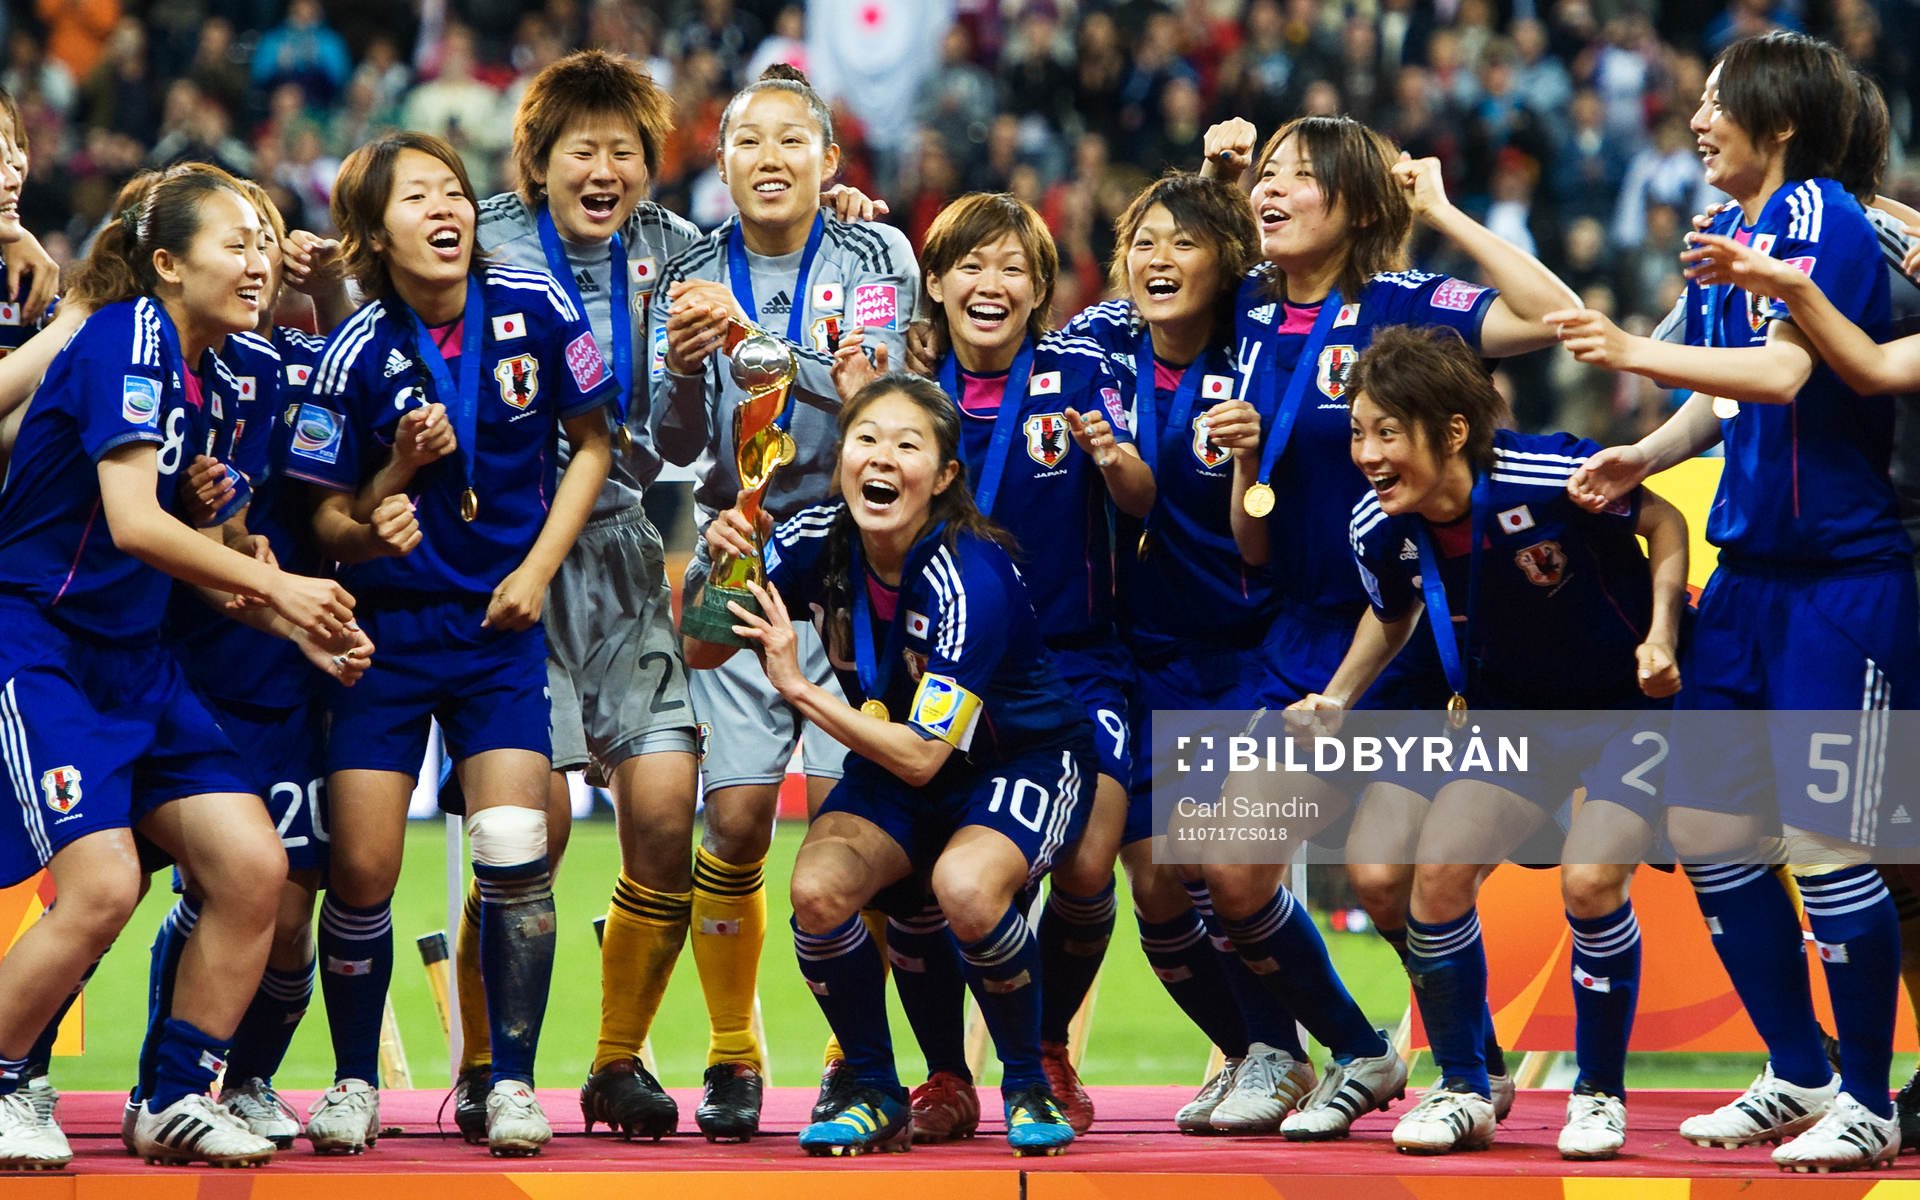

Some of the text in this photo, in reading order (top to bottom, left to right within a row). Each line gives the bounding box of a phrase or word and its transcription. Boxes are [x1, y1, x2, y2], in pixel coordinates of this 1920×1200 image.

[761, 304, 793, 314] adida
[857, 286, 885, 303] LIVE
[857, 296, 893, 313] YOUR
[857, 306, 895, 325] GOALS
[567, 339, 588, 364] LIVE
[572, 346, 597, 374] YOUR
[578, 352, 602, 386] GOALS
[1238, 336, 1263, 402] 4
[156, 407, 185, 475] 8
[1034, 469, 1068, 479] JAPAN
[1096, 708, 1126, 760] 9
[1620, 731, 1670, 797] 2
[1806, 732, 1853, 804] 5
[988, 777, 1050, 833] 10
